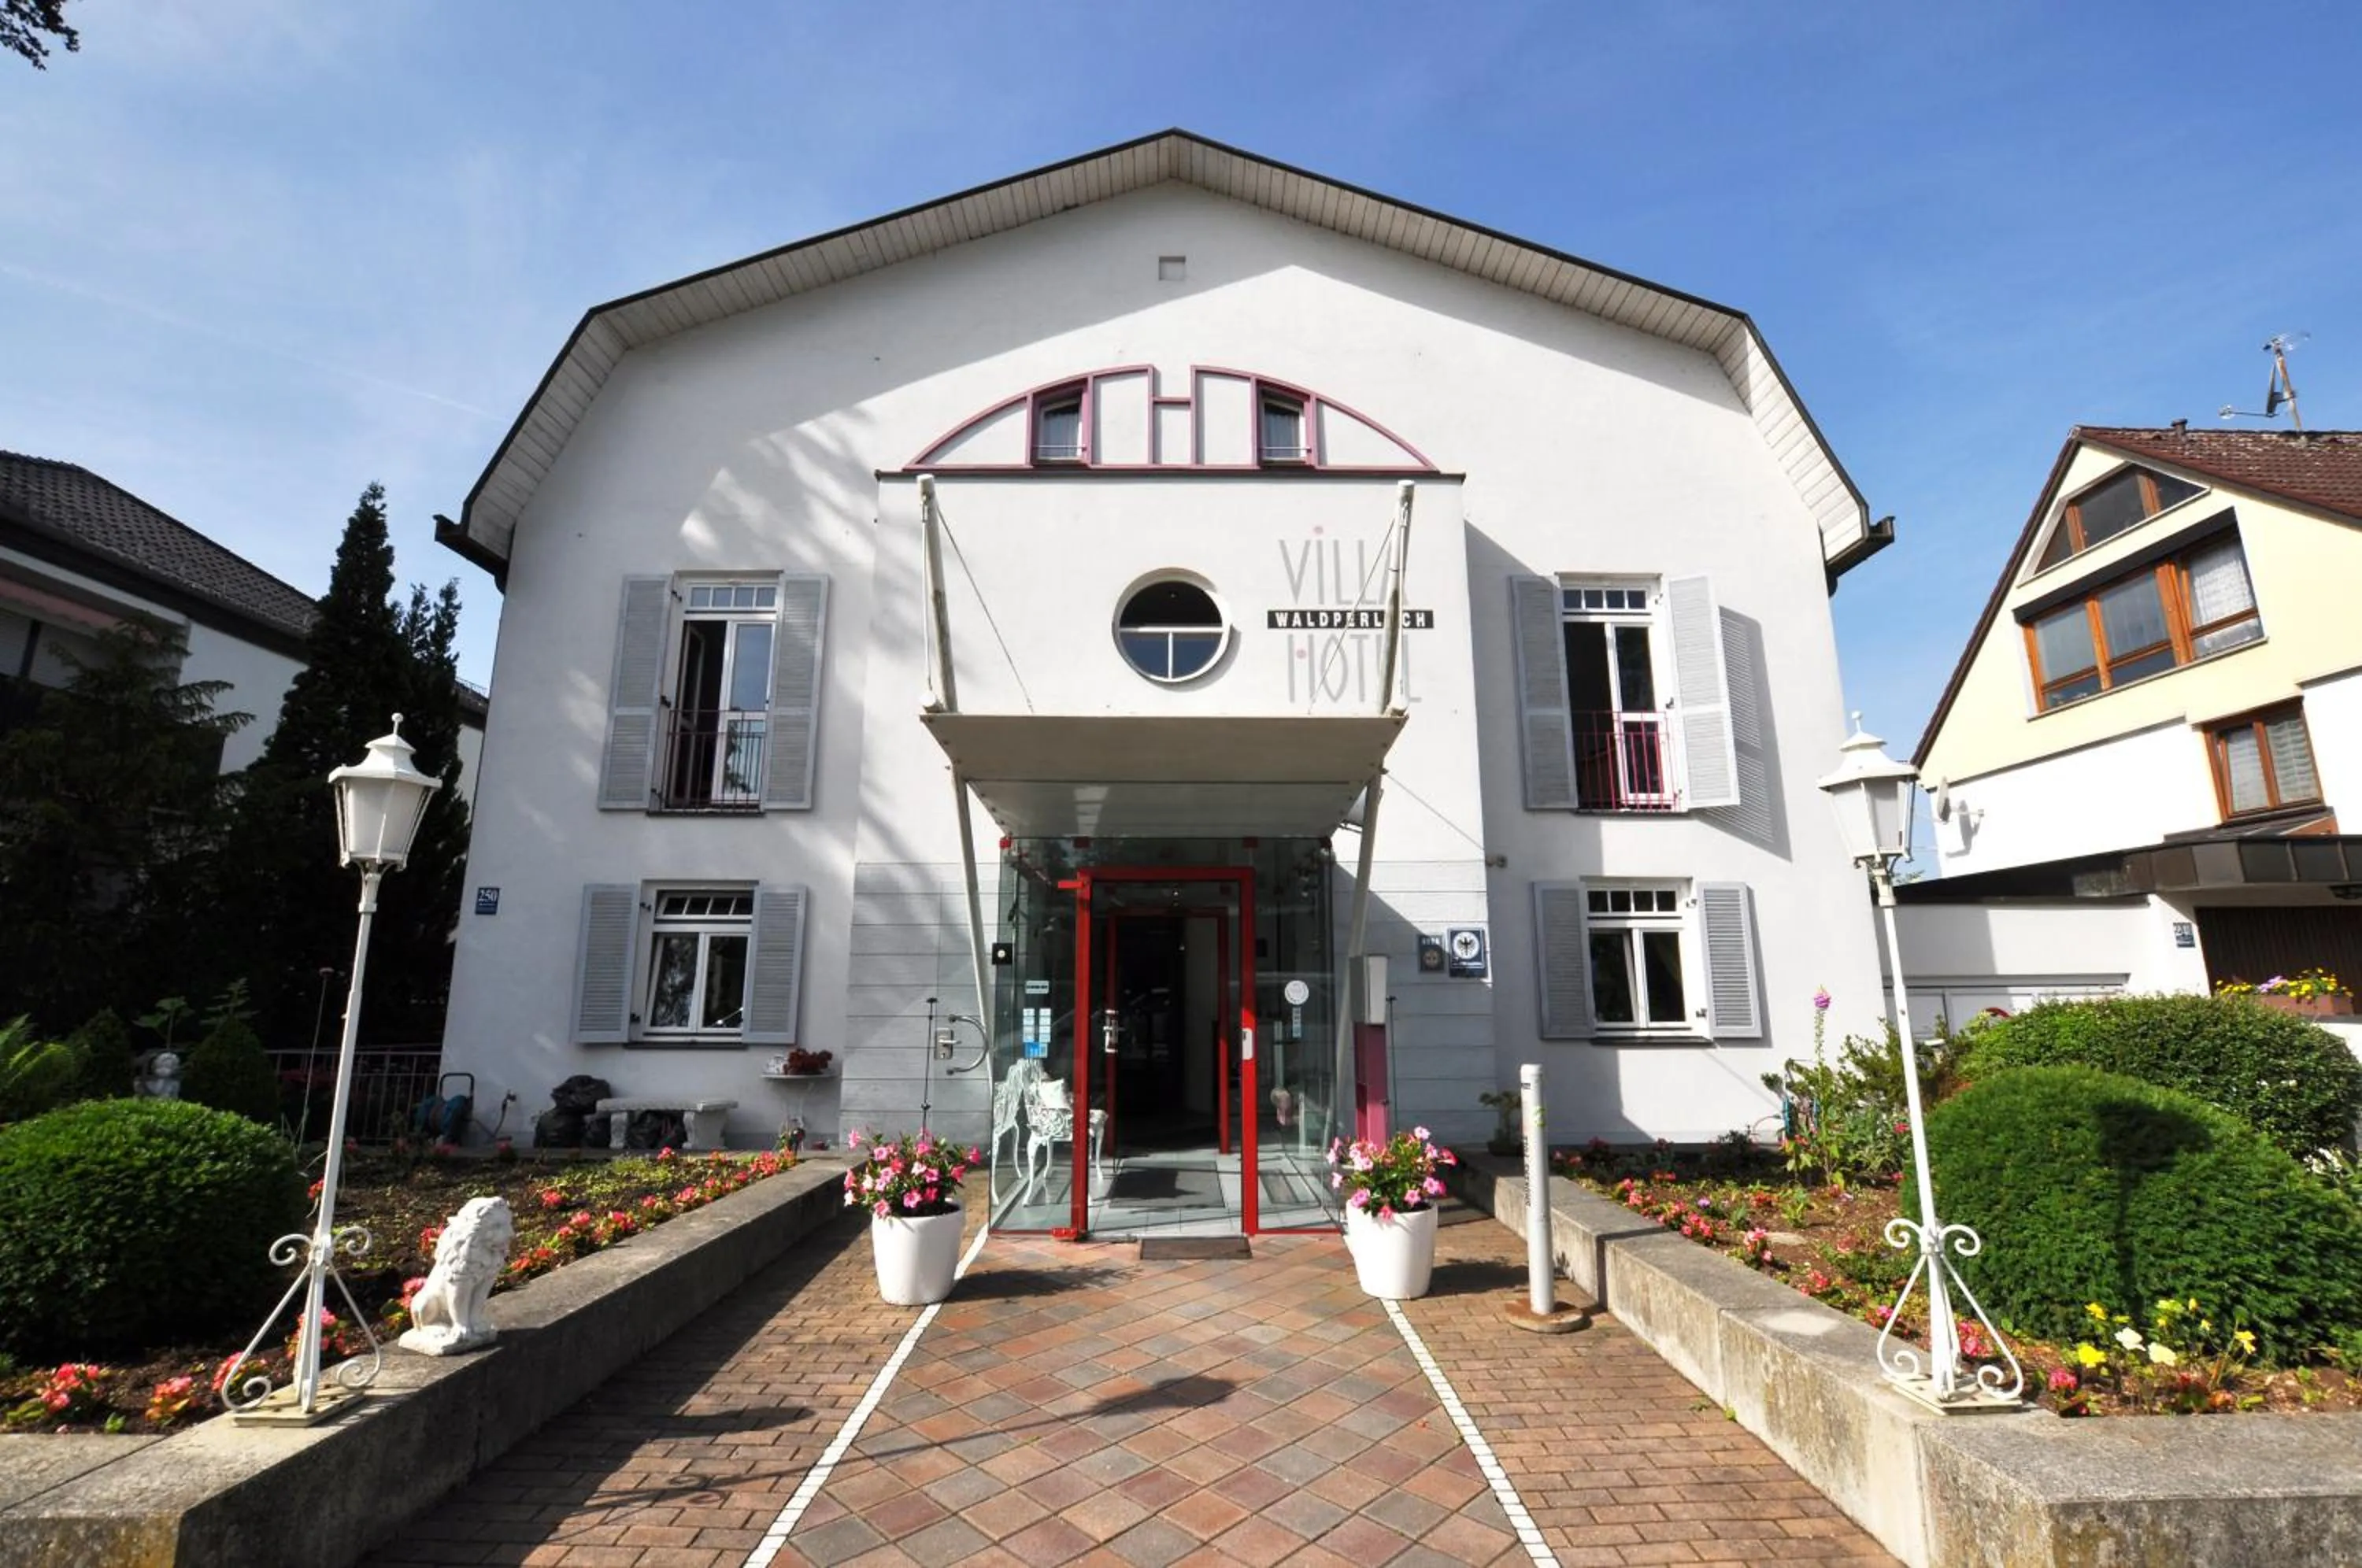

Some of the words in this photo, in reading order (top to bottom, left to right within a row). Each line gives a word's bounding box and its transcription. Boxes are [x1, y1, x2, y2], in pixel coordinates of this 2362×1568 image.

[1275, 611, 1427, 627] WALDPERLCH
[1287, 634, 1422, 703] HOTL
[479, 889, 498, 902] 250
